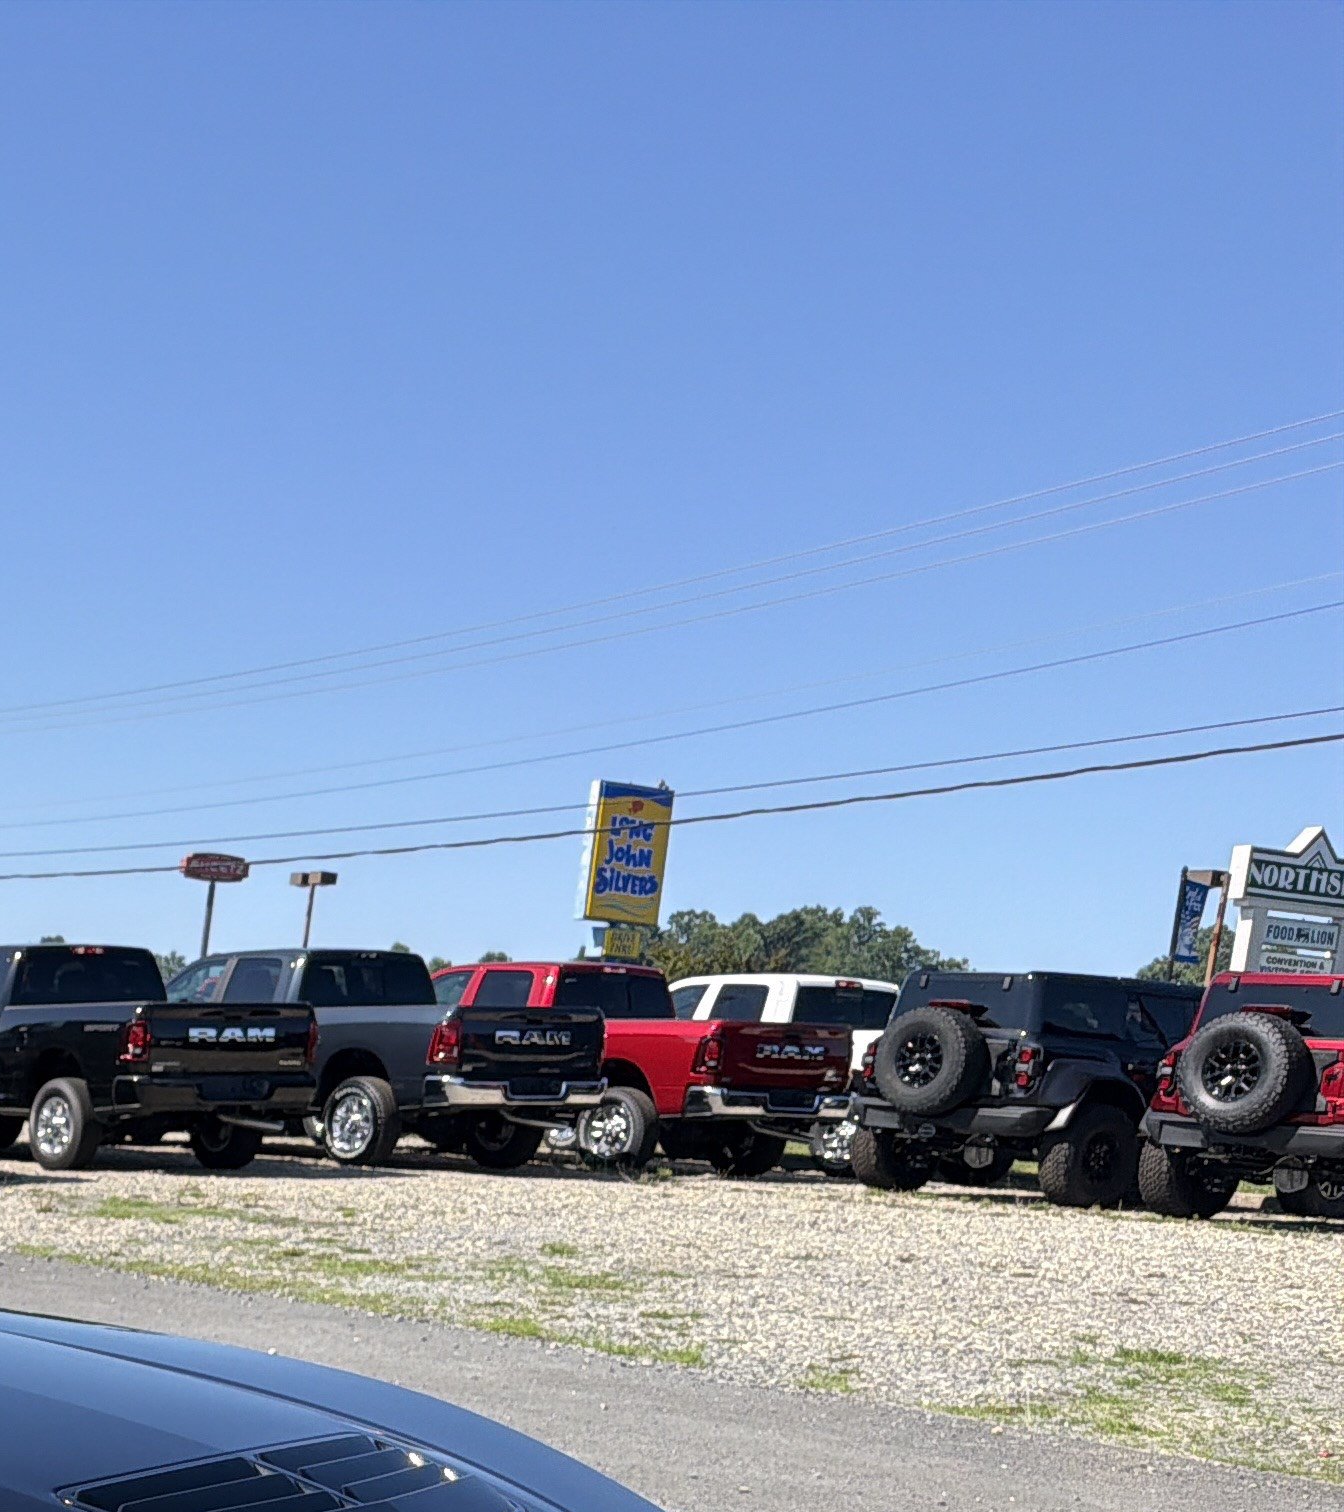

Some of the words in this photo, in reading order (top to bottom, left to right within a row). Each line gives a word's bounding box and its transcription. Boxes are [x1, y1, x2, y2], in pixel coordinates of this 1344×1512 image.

[1248, 861, 1344, 898] NORTHS
[1265, 924, 1295, 941] FOOD
[1310, 928, 1335, 945] LION
[1265, 956, 1318, 969] CONVENTION
[188, 1027, 277, 1043] RAM
[494, 1030, 572, 1046] RAM
[755, 1043, 826, 1061] RAM
